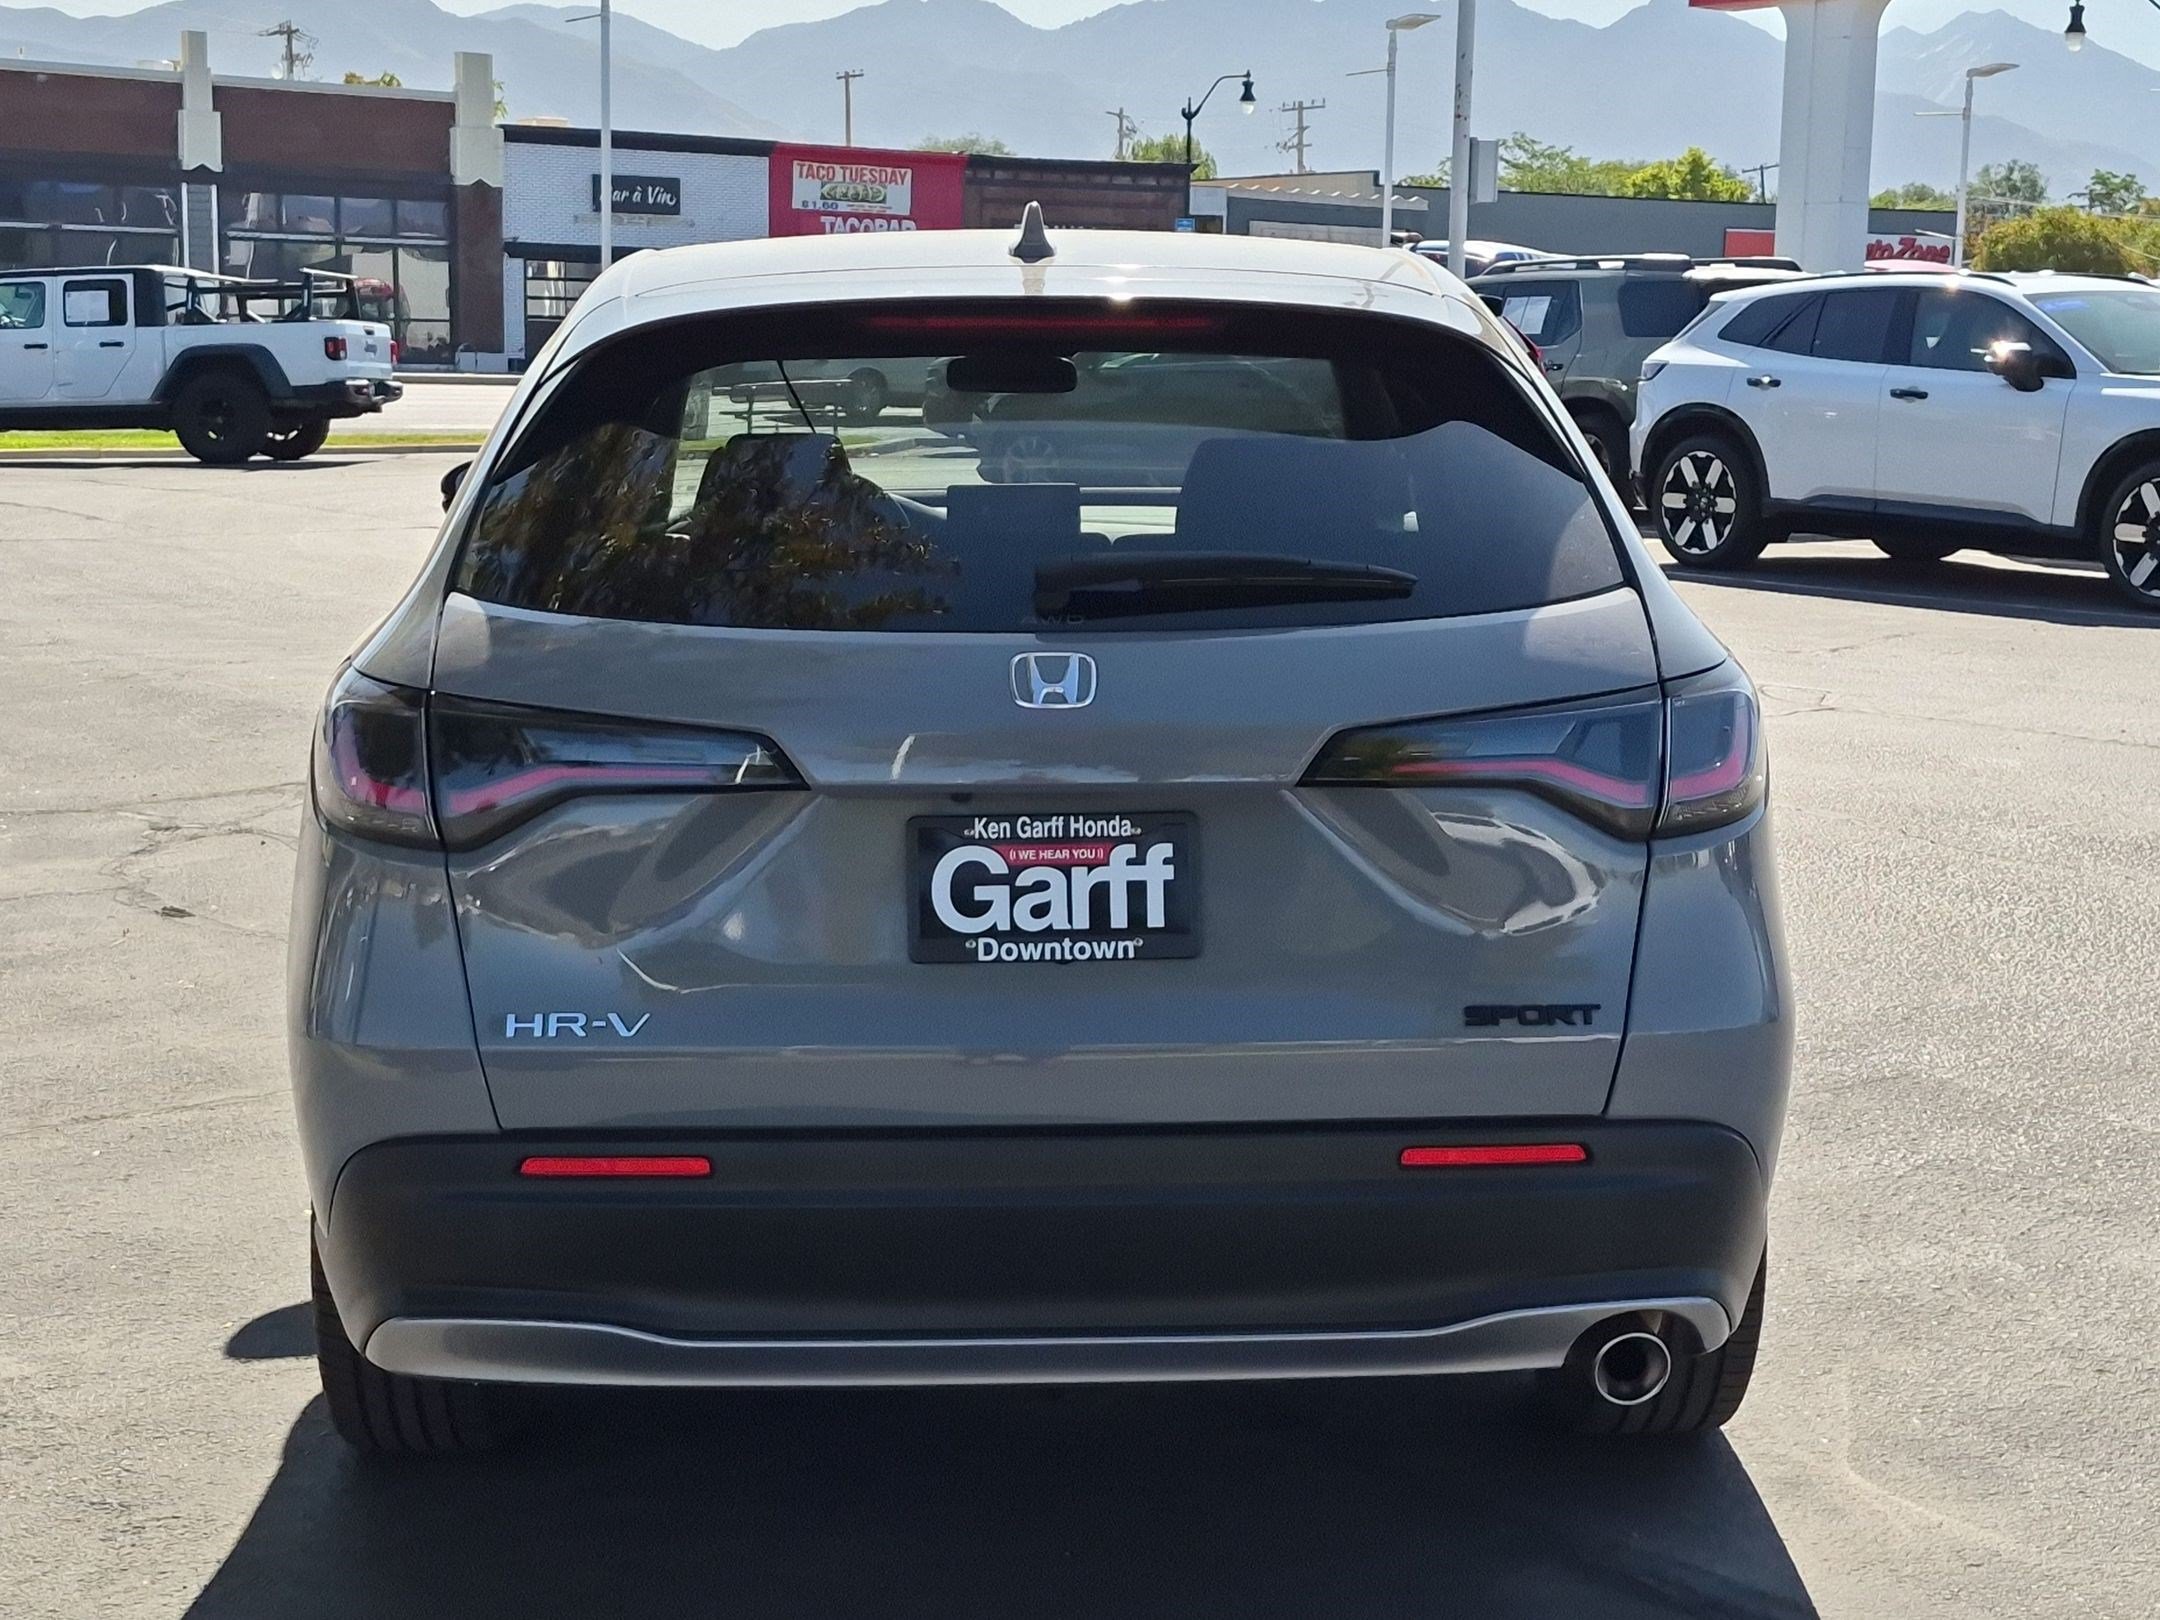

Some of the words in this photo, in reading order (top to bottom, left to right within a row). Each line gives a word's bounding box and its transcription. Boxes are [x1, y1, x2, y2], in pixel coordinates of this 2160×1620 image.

[796, 163, 836, 182] TACO
[840, 166, 909, 186] TUESDAY
[632, 185, 643, 203] à
[648, 185, 677, 206] Vin
[1866, 237, 1951, 264] utoZone
[1021, 613, 1084, 625] AWD
[973, 816, 1011, 839] Ken
[1016, 816, 1065, 839] Garff
[1069, 815, 1132, 838] Honda
[1017, 849, 1037, 860] WE
[1039, 849, 1070, 860] HEAR
[1071, 848, 1097, 860] YOU
[931, 842, 1175, 934] Garff
[977, 937, 1136, 962] Downtown
[505, 1012, 651, 1038] HR-V
[1463, 1003, 1602, 1026] SPORT
